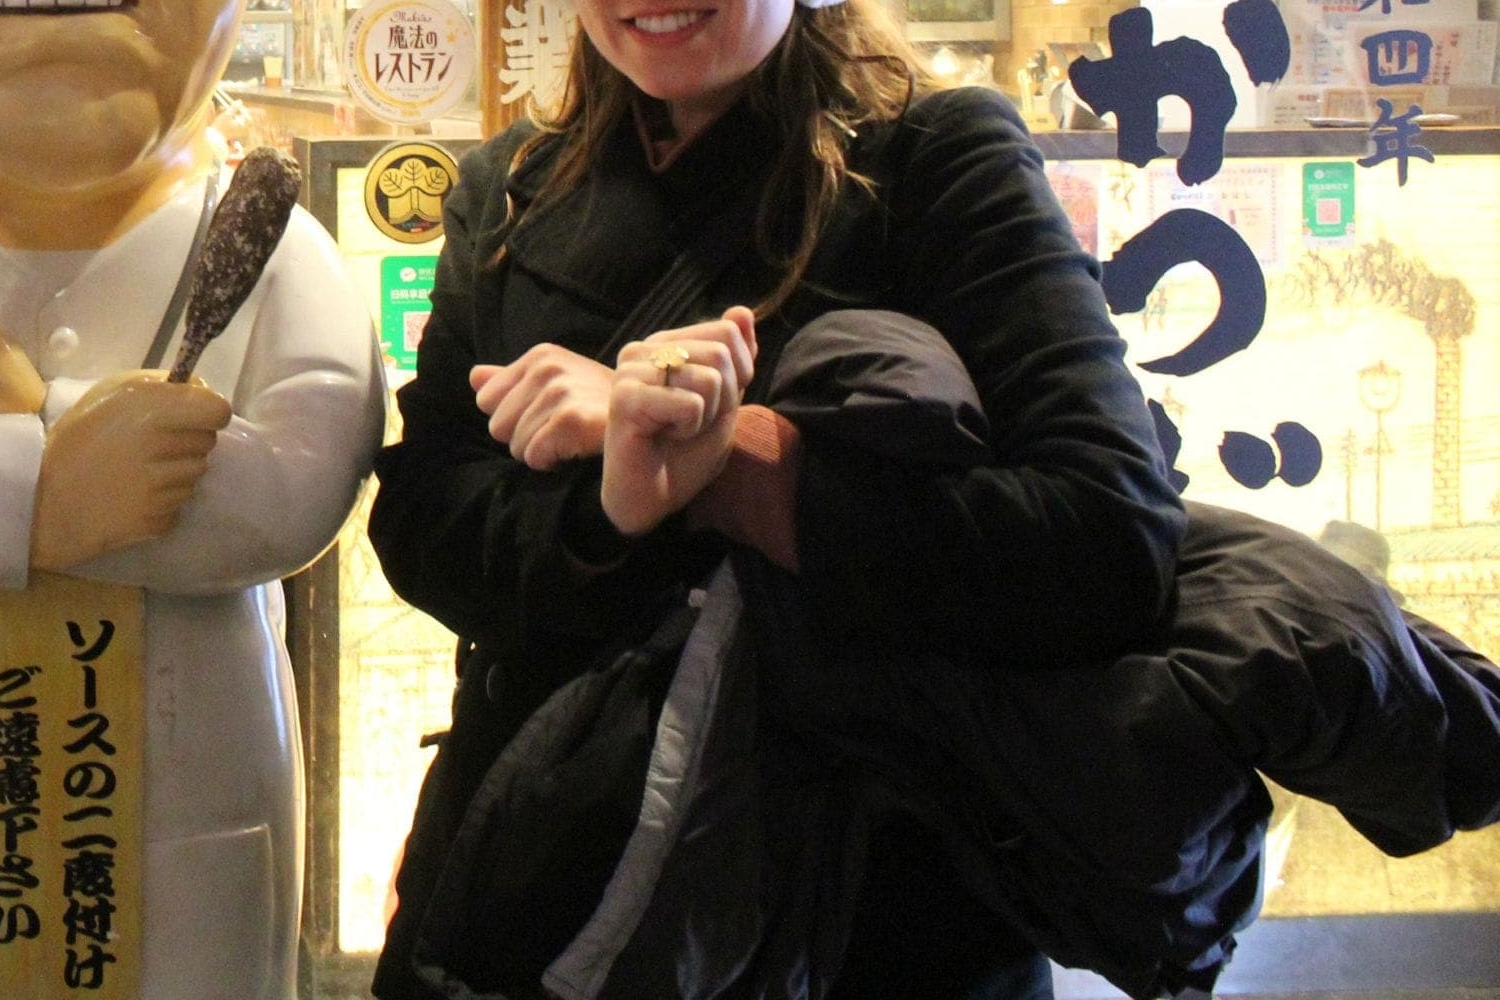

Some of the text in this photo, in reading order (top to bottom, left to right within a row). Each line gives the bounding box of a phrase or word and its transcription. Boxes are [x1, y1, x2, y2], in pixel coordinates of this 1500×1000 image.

[387, 25, 438, 50] 魔法の
[374, 52, 454, 84] レストラン
[62, 619, 117, 990] ソースの二度付け
